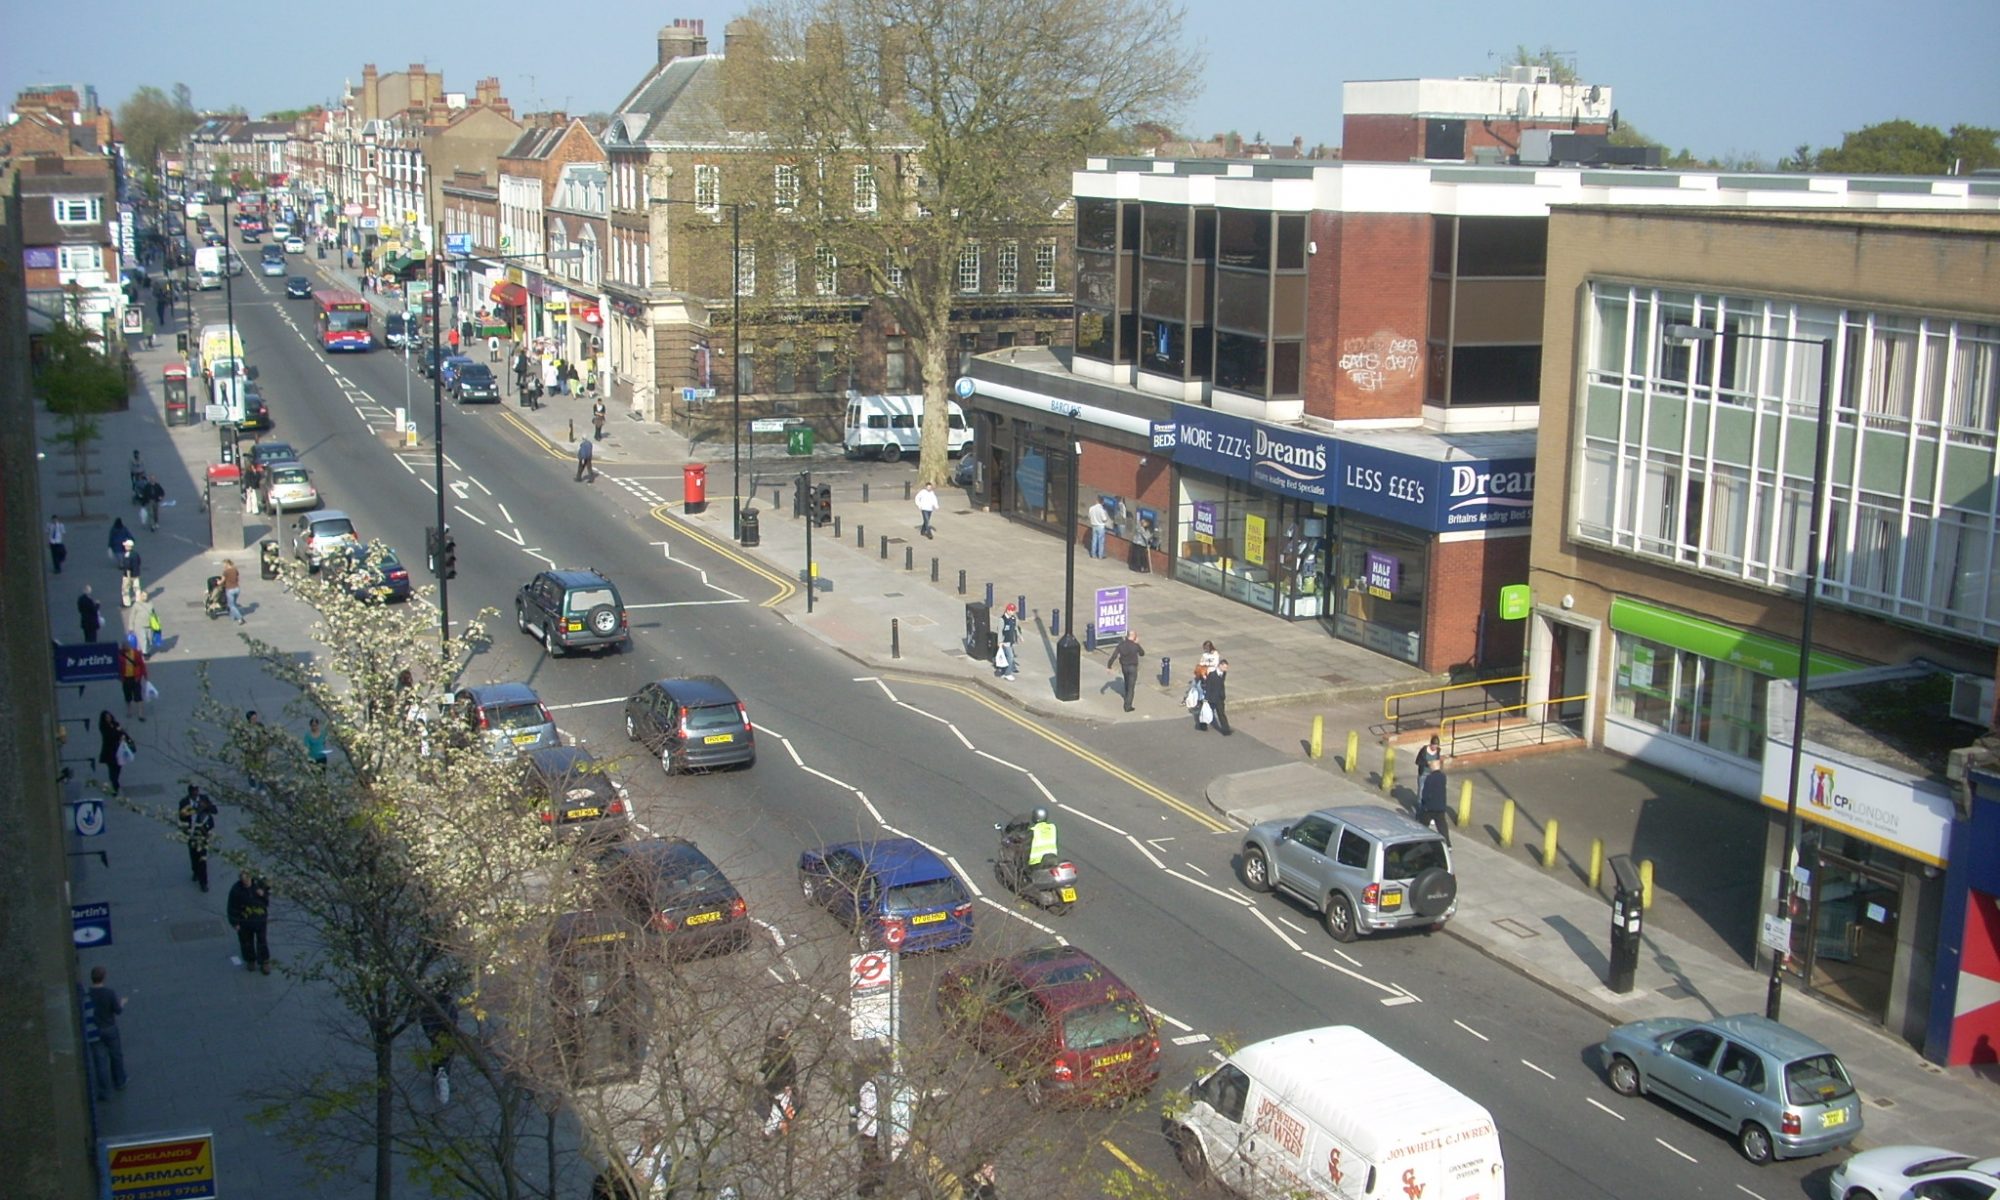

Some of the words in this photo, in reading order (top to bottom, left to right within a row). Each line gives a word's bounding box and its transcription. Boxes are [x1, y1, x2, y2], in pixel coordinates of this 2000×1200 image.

[1153, 433, 1176, 447] BEDS
[1180, 425, 1212, 450] MORE
[1256, 429, 1327, 471] Dreams
[1347, 465, 1382, 493] LESS
[1448, 513, 1477, 524] Britains
[1479, 511, 1507, 523] leading
[1372, 561, 1391, 577] HALF
[1371, 573, 1391, 590] PRICE
[1100, 603, 1124, 617] HALF
[1098, 614, 1125, 629] PRICE
[1461, 1124, 1491, 1141] WREN
[119, 1149, 193, 1164] AUCKLANDS
[111, 1165, 205, 1185] PHARMACY
